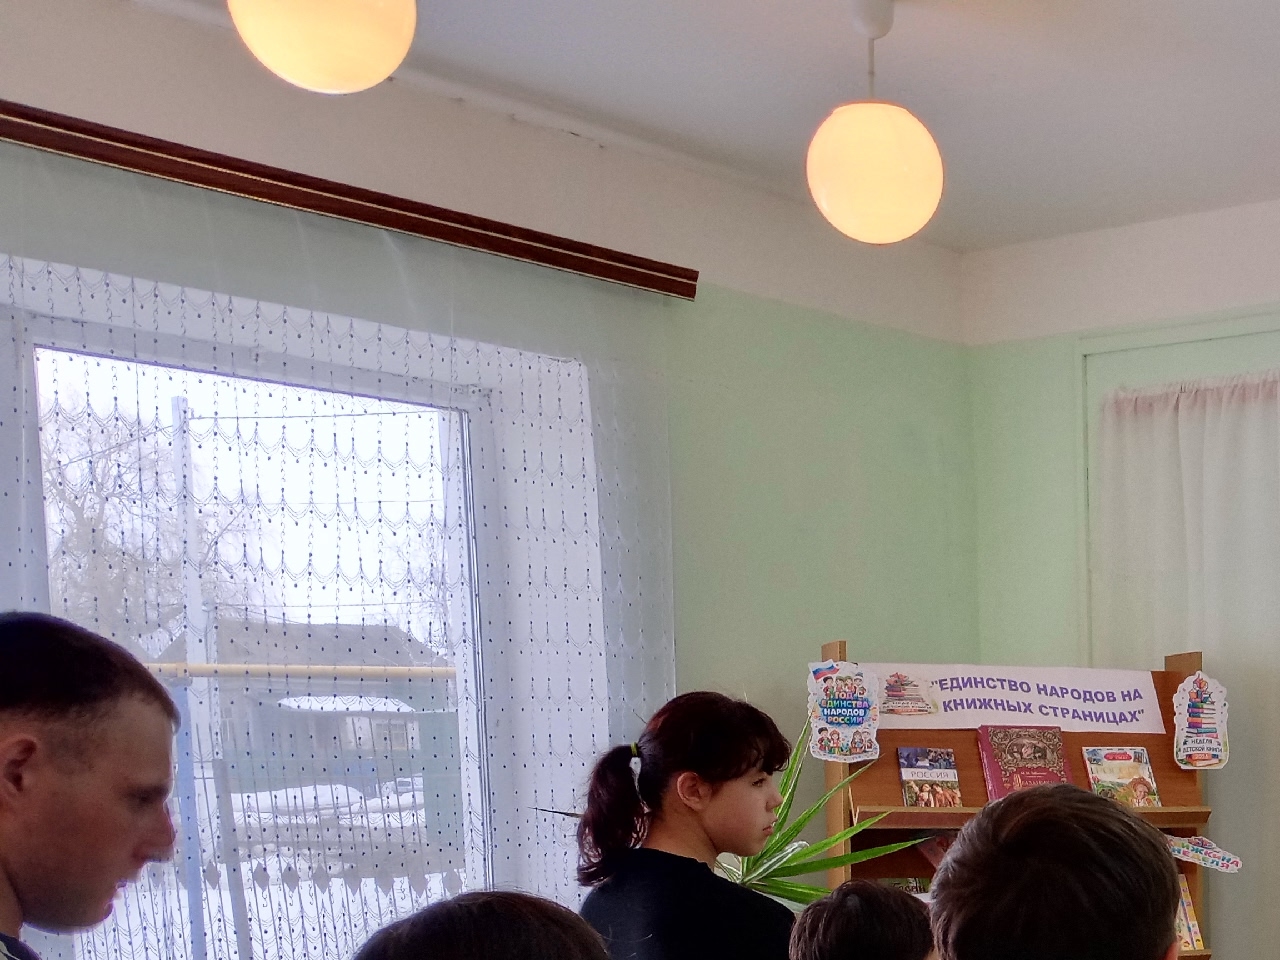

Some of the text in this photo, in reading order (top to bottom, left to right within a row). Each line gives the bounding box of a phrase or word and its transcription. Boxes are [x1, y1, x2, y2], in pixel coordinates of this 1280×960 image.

[931, 677, 1143, 704] "ЕДИНСТВО НАРОДОВ НА
[835, 691, 853, 700] ГОД
[821, 700, 869, 708] ЕДИНСТВА
[823, 708, 865, 717] НАРОДОВ
[942, 698, 1144, 726] КНИЖНЫХ СТРАНИЦАХ"
[827, 716, 863, 724] РОССИИ
[911, 770, 949, 779] РОССИЯ
